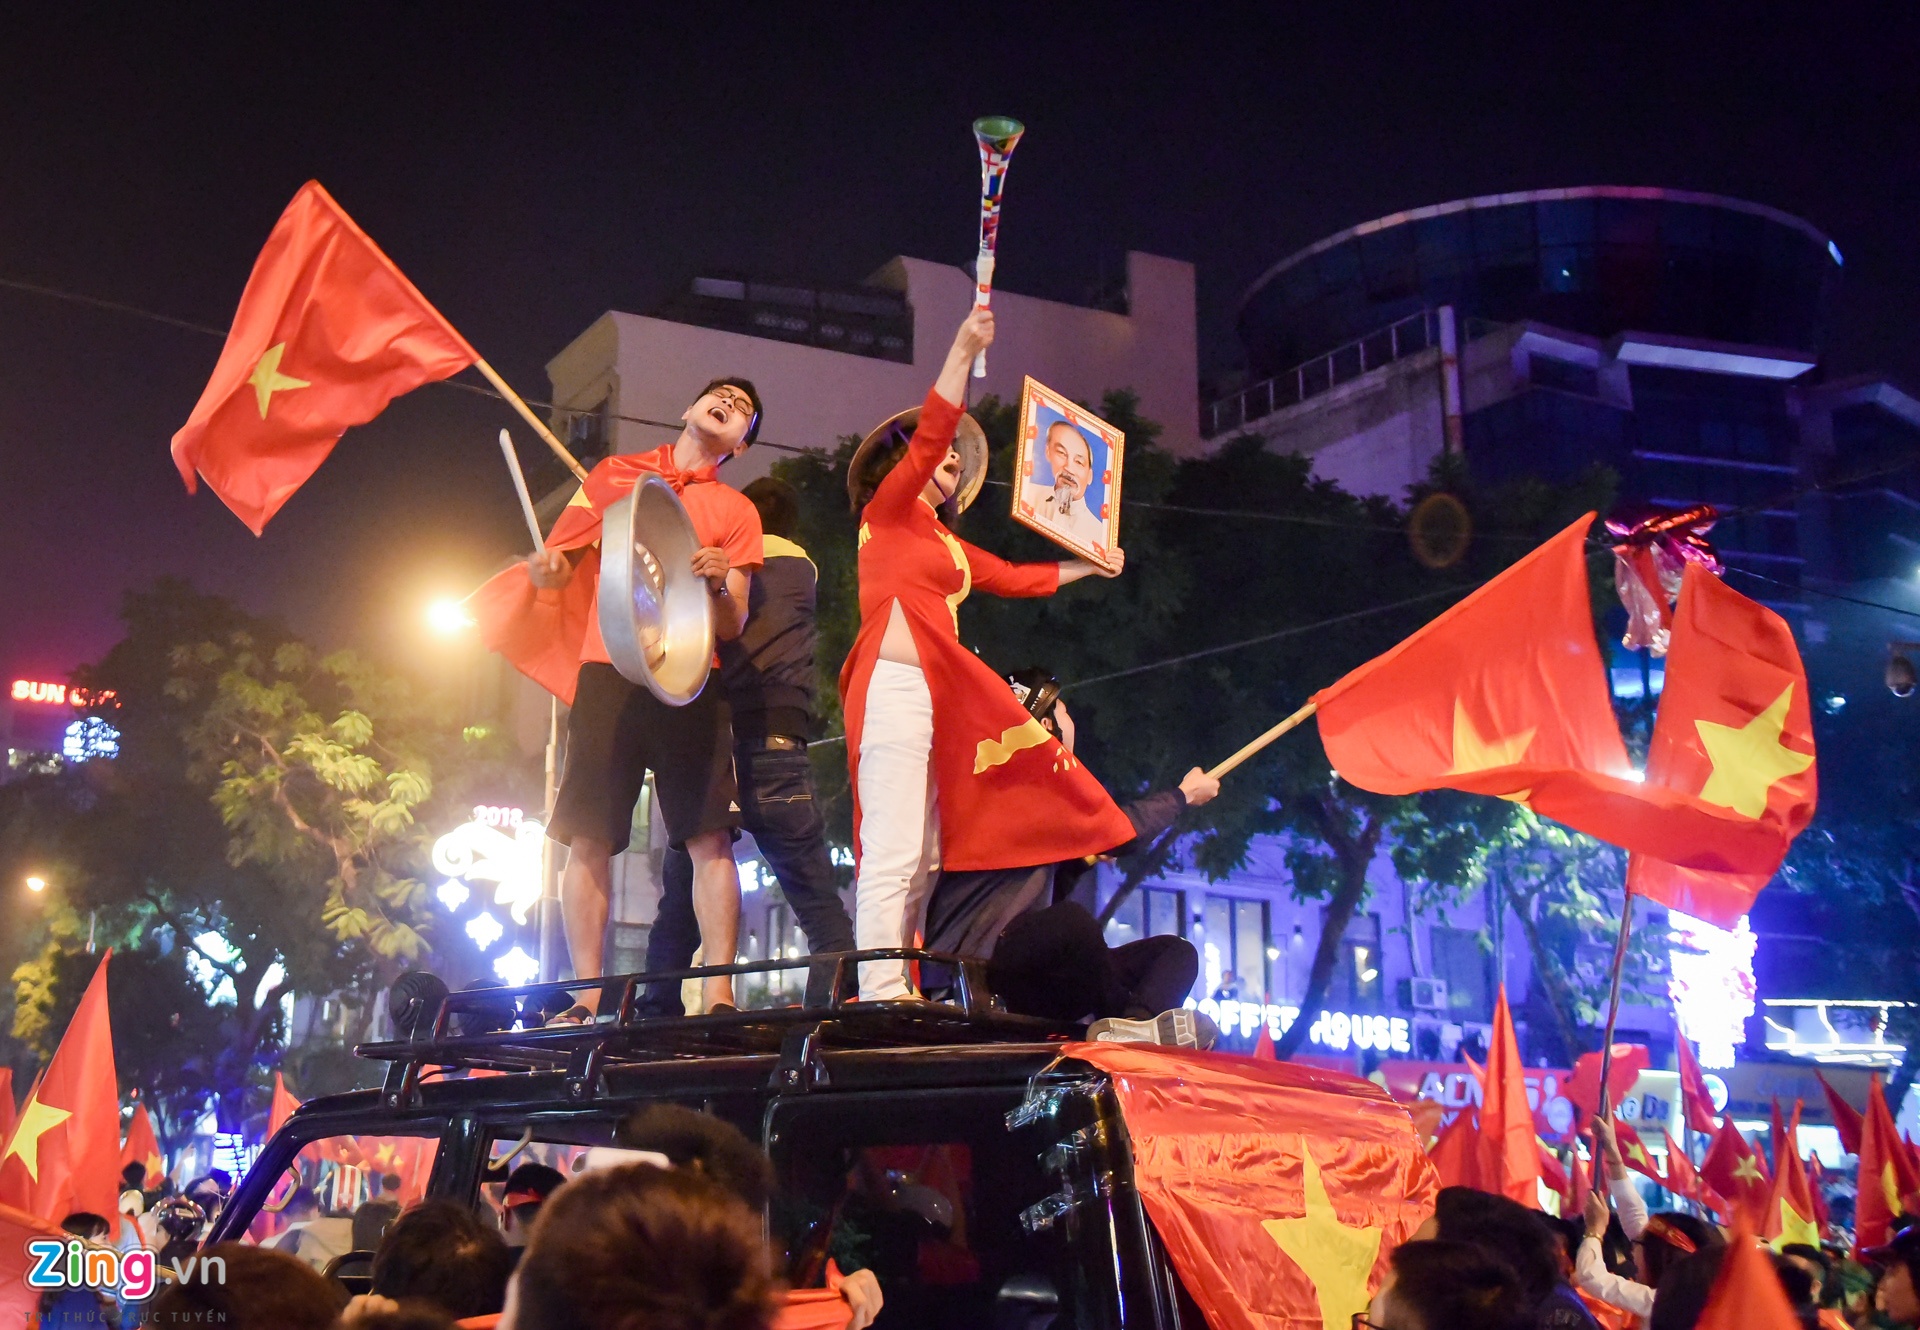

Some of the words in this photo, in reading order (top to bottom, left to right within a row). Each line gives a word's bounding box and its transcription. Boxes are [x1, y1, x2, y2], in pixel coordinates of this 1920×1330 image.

[12, 680, 66, 704] SUN
[473, 805, 524, 828] 2018
[1182, 996, 1301, 1042] OFFEE
